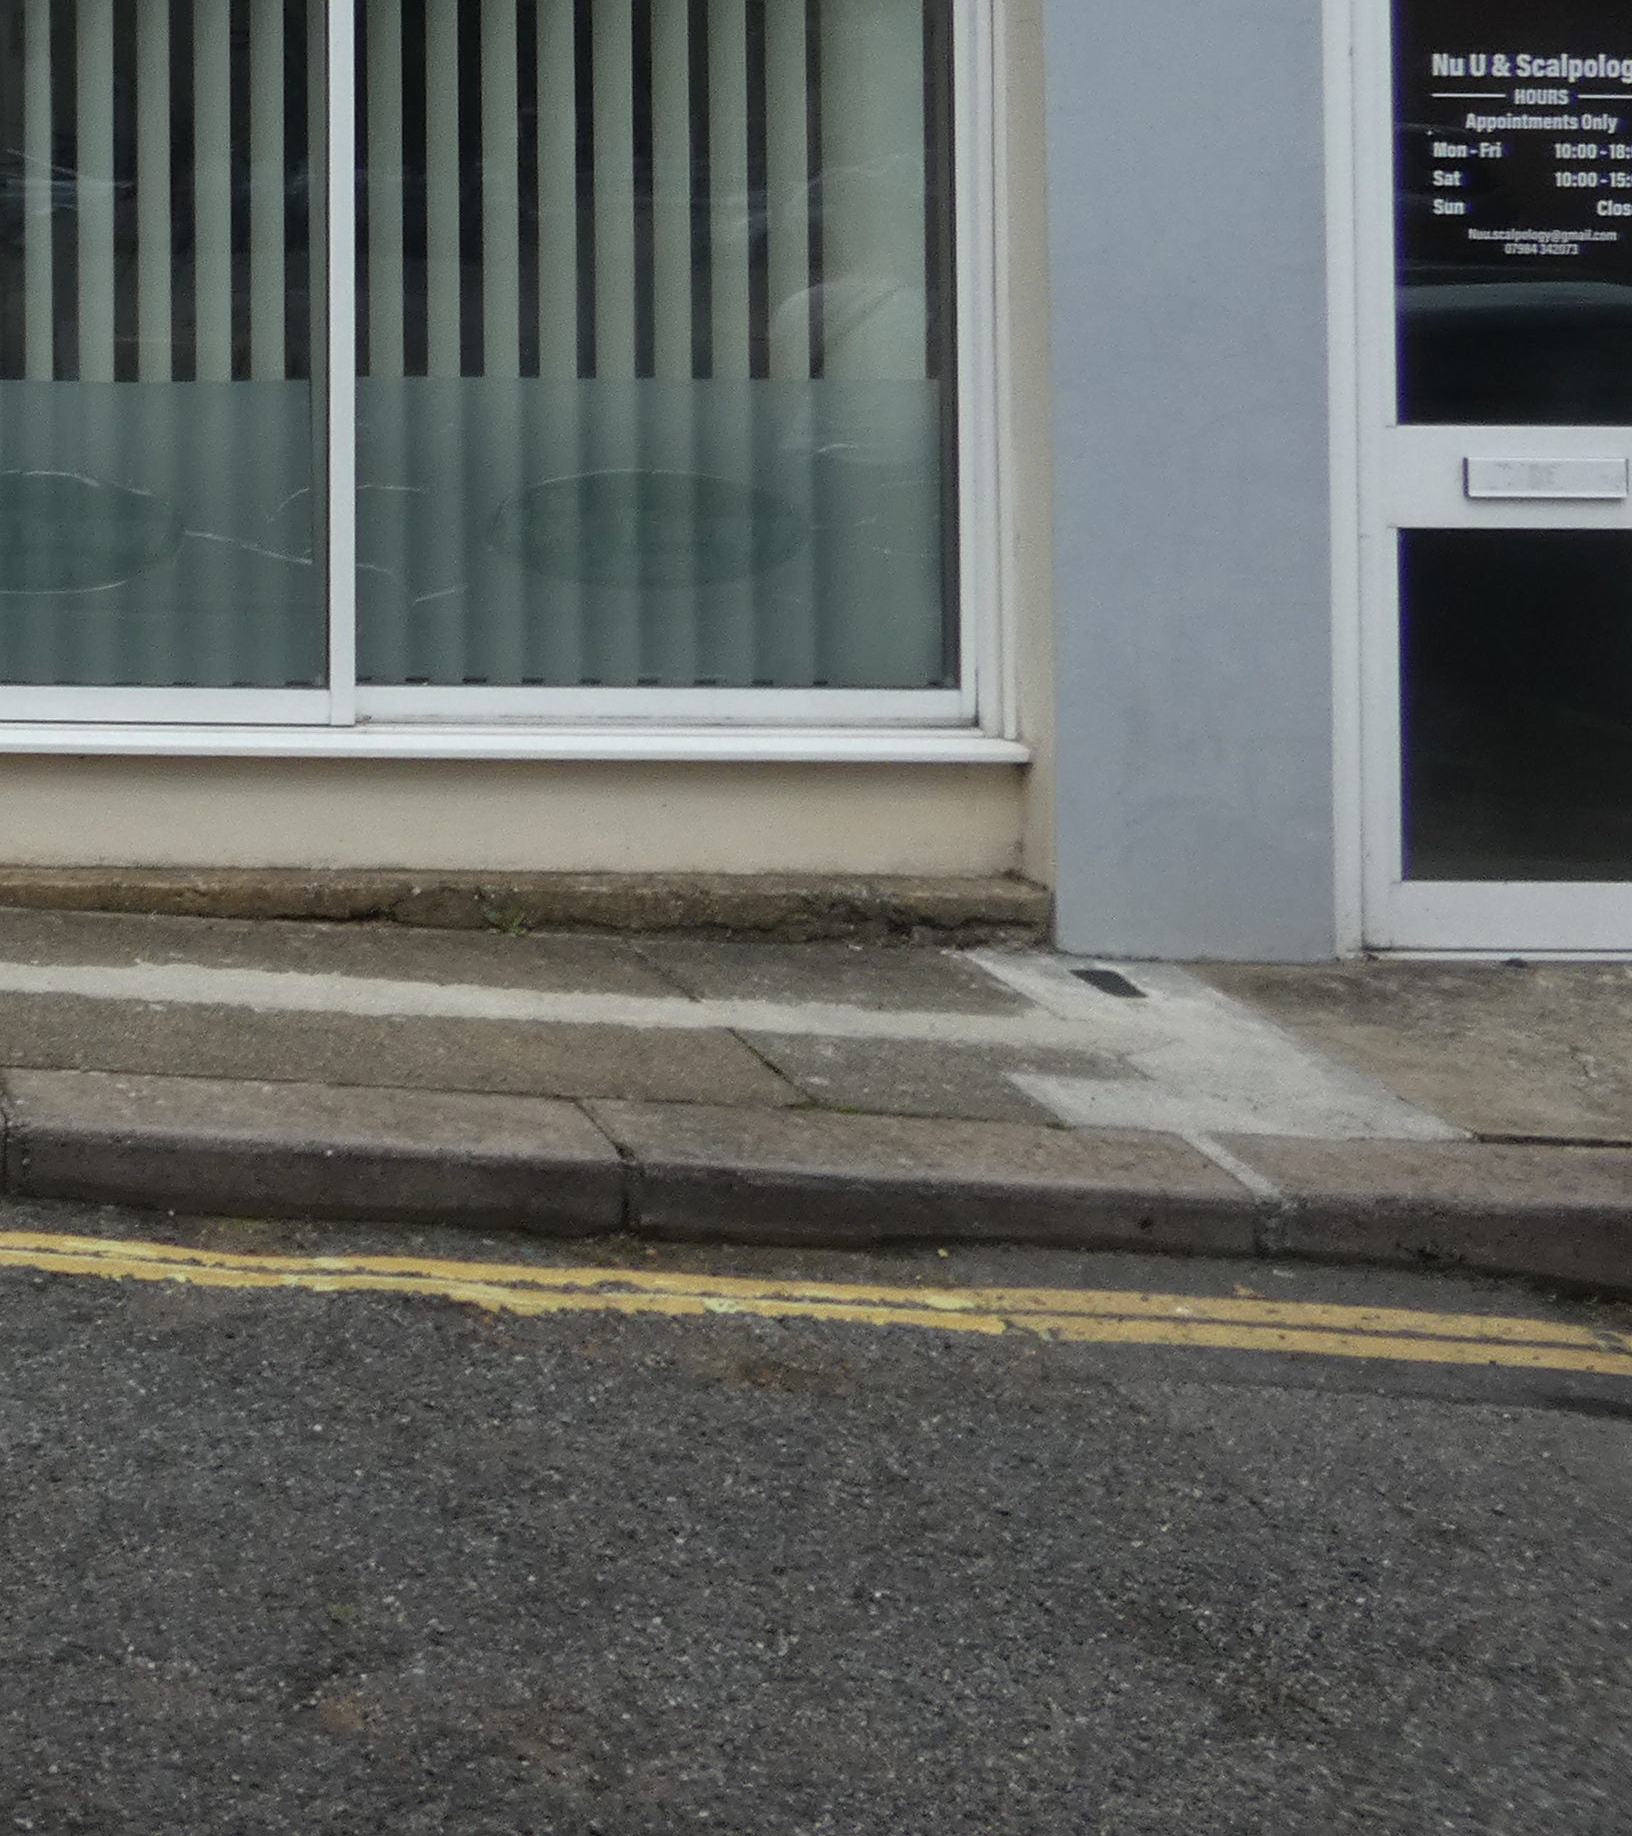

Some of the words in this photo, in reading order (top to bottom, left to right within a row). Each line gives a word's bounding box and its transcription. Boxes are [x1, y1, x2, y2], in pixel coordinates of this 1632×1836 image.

[1432, 53, 1465, 77] Nu
[1469, 54, 1486, 77] U
[1491, 53, 1511, 77] &
[1514, 89, 1569, 105] HOURS
[1465, 113, 1578, 132] Appointments
[1581, 113, 1619, 134] Only
[1433, 142, 1467, 158] Mon
[1479, 142, 1502, 158] Fri
[1555, 143, 1598, 159] 10:00
[1609, 143, 1632, 159] 18:
[1432, 170, 1463, 187] Sat
[1555, 171, 1598, 187] 10:00
[1609, 171, 1632, 188] 15:
[1433, 198, 1465, 215] Sun
